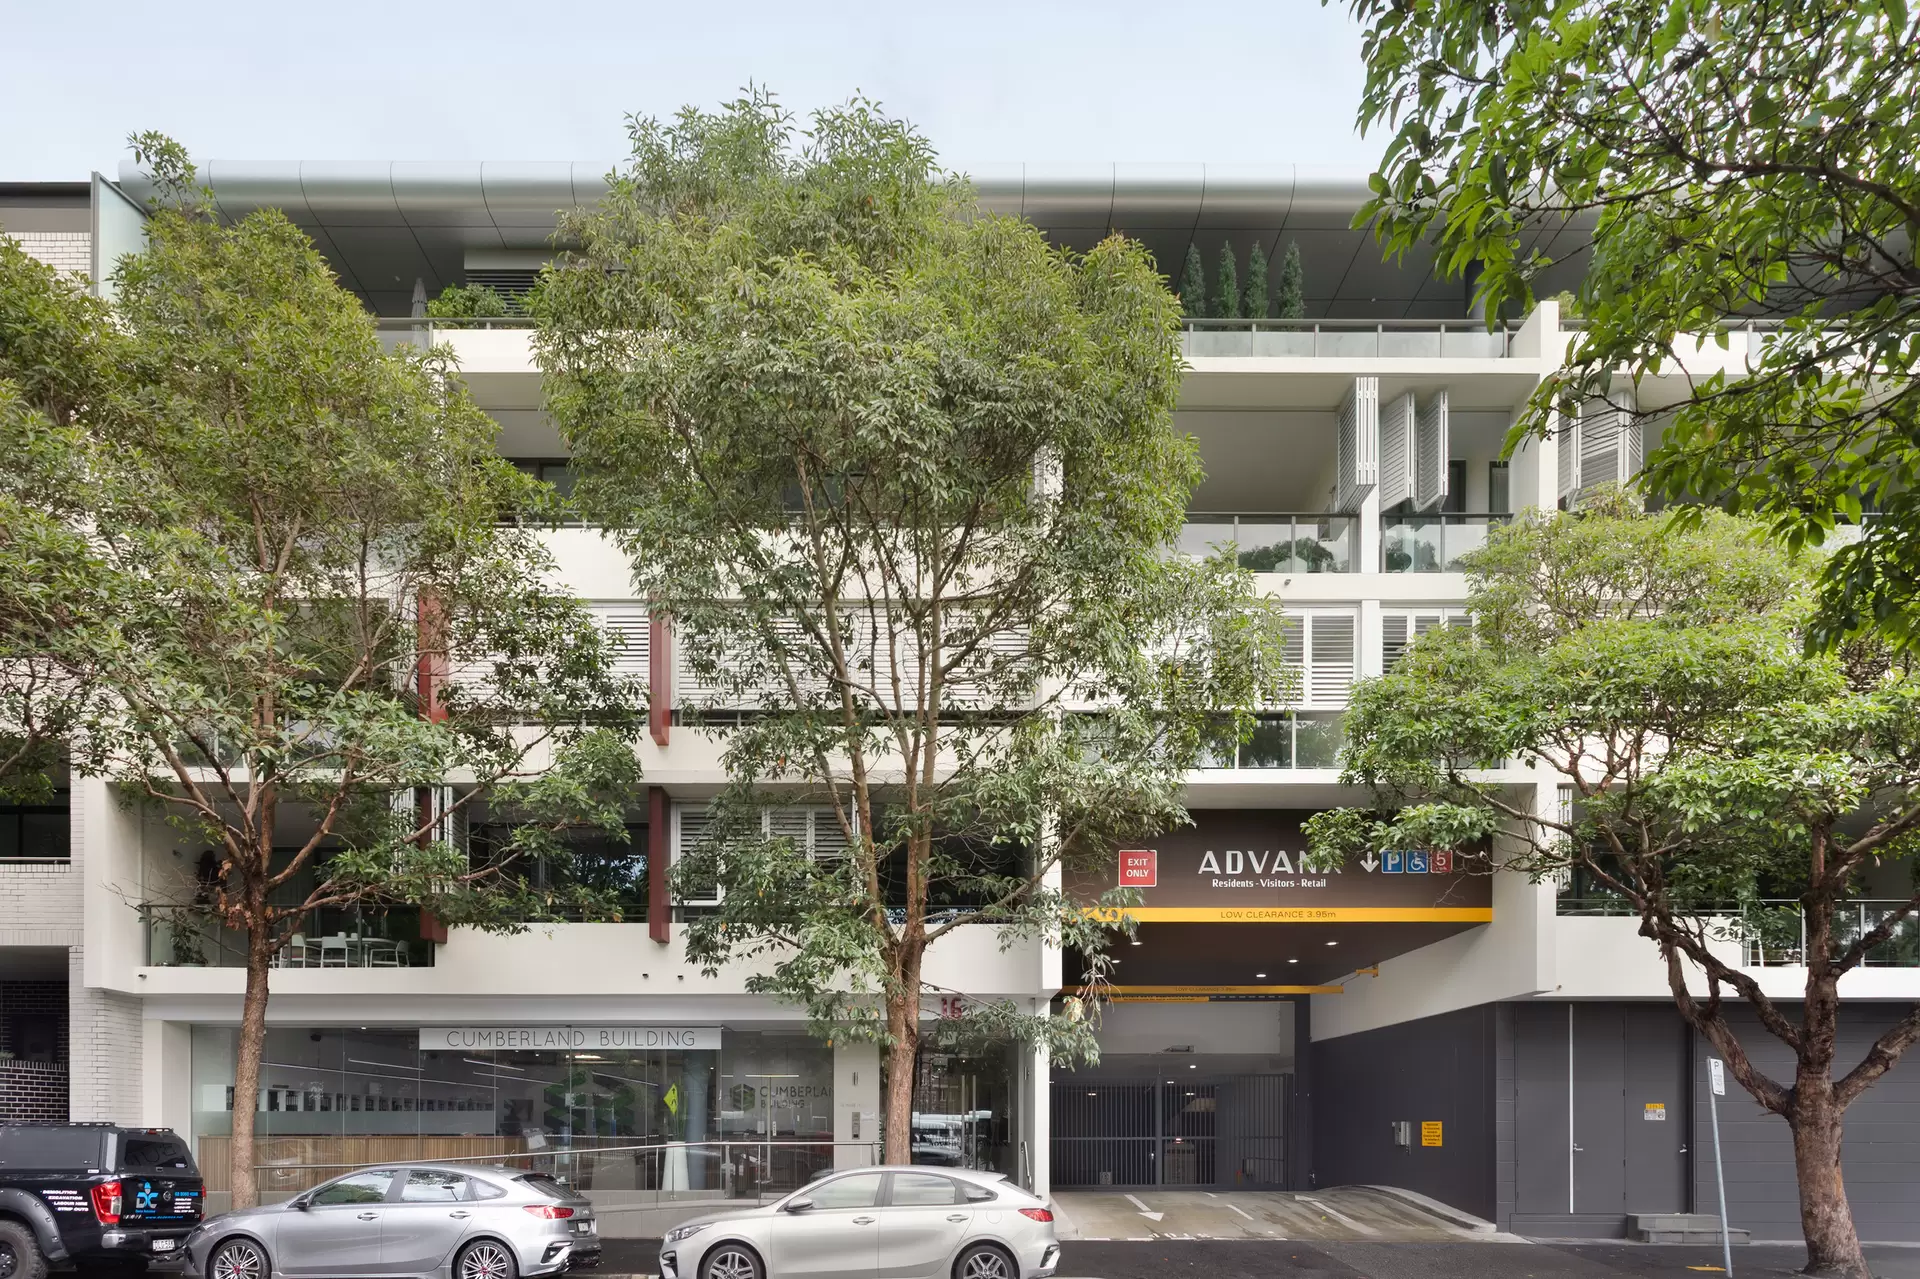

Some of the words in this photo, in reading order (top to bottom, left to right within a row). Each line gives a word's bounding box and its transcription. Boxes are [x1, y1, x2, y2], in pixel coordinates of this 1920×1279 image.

[1127, 858, 1149, 866] EXIT
[1436, 852, 1447, 866] 5
[1126, 869, 1149, 877] ONLY
[1212, 878, 1254, 888] Residents
[1260, 878, 1295, 888] Visitors
[1301, 878, 1327, 888] Retail
[446, 1030, 585, 1047] CUMBERLAND
[600, 1030, 696, 1047] BUILDING
